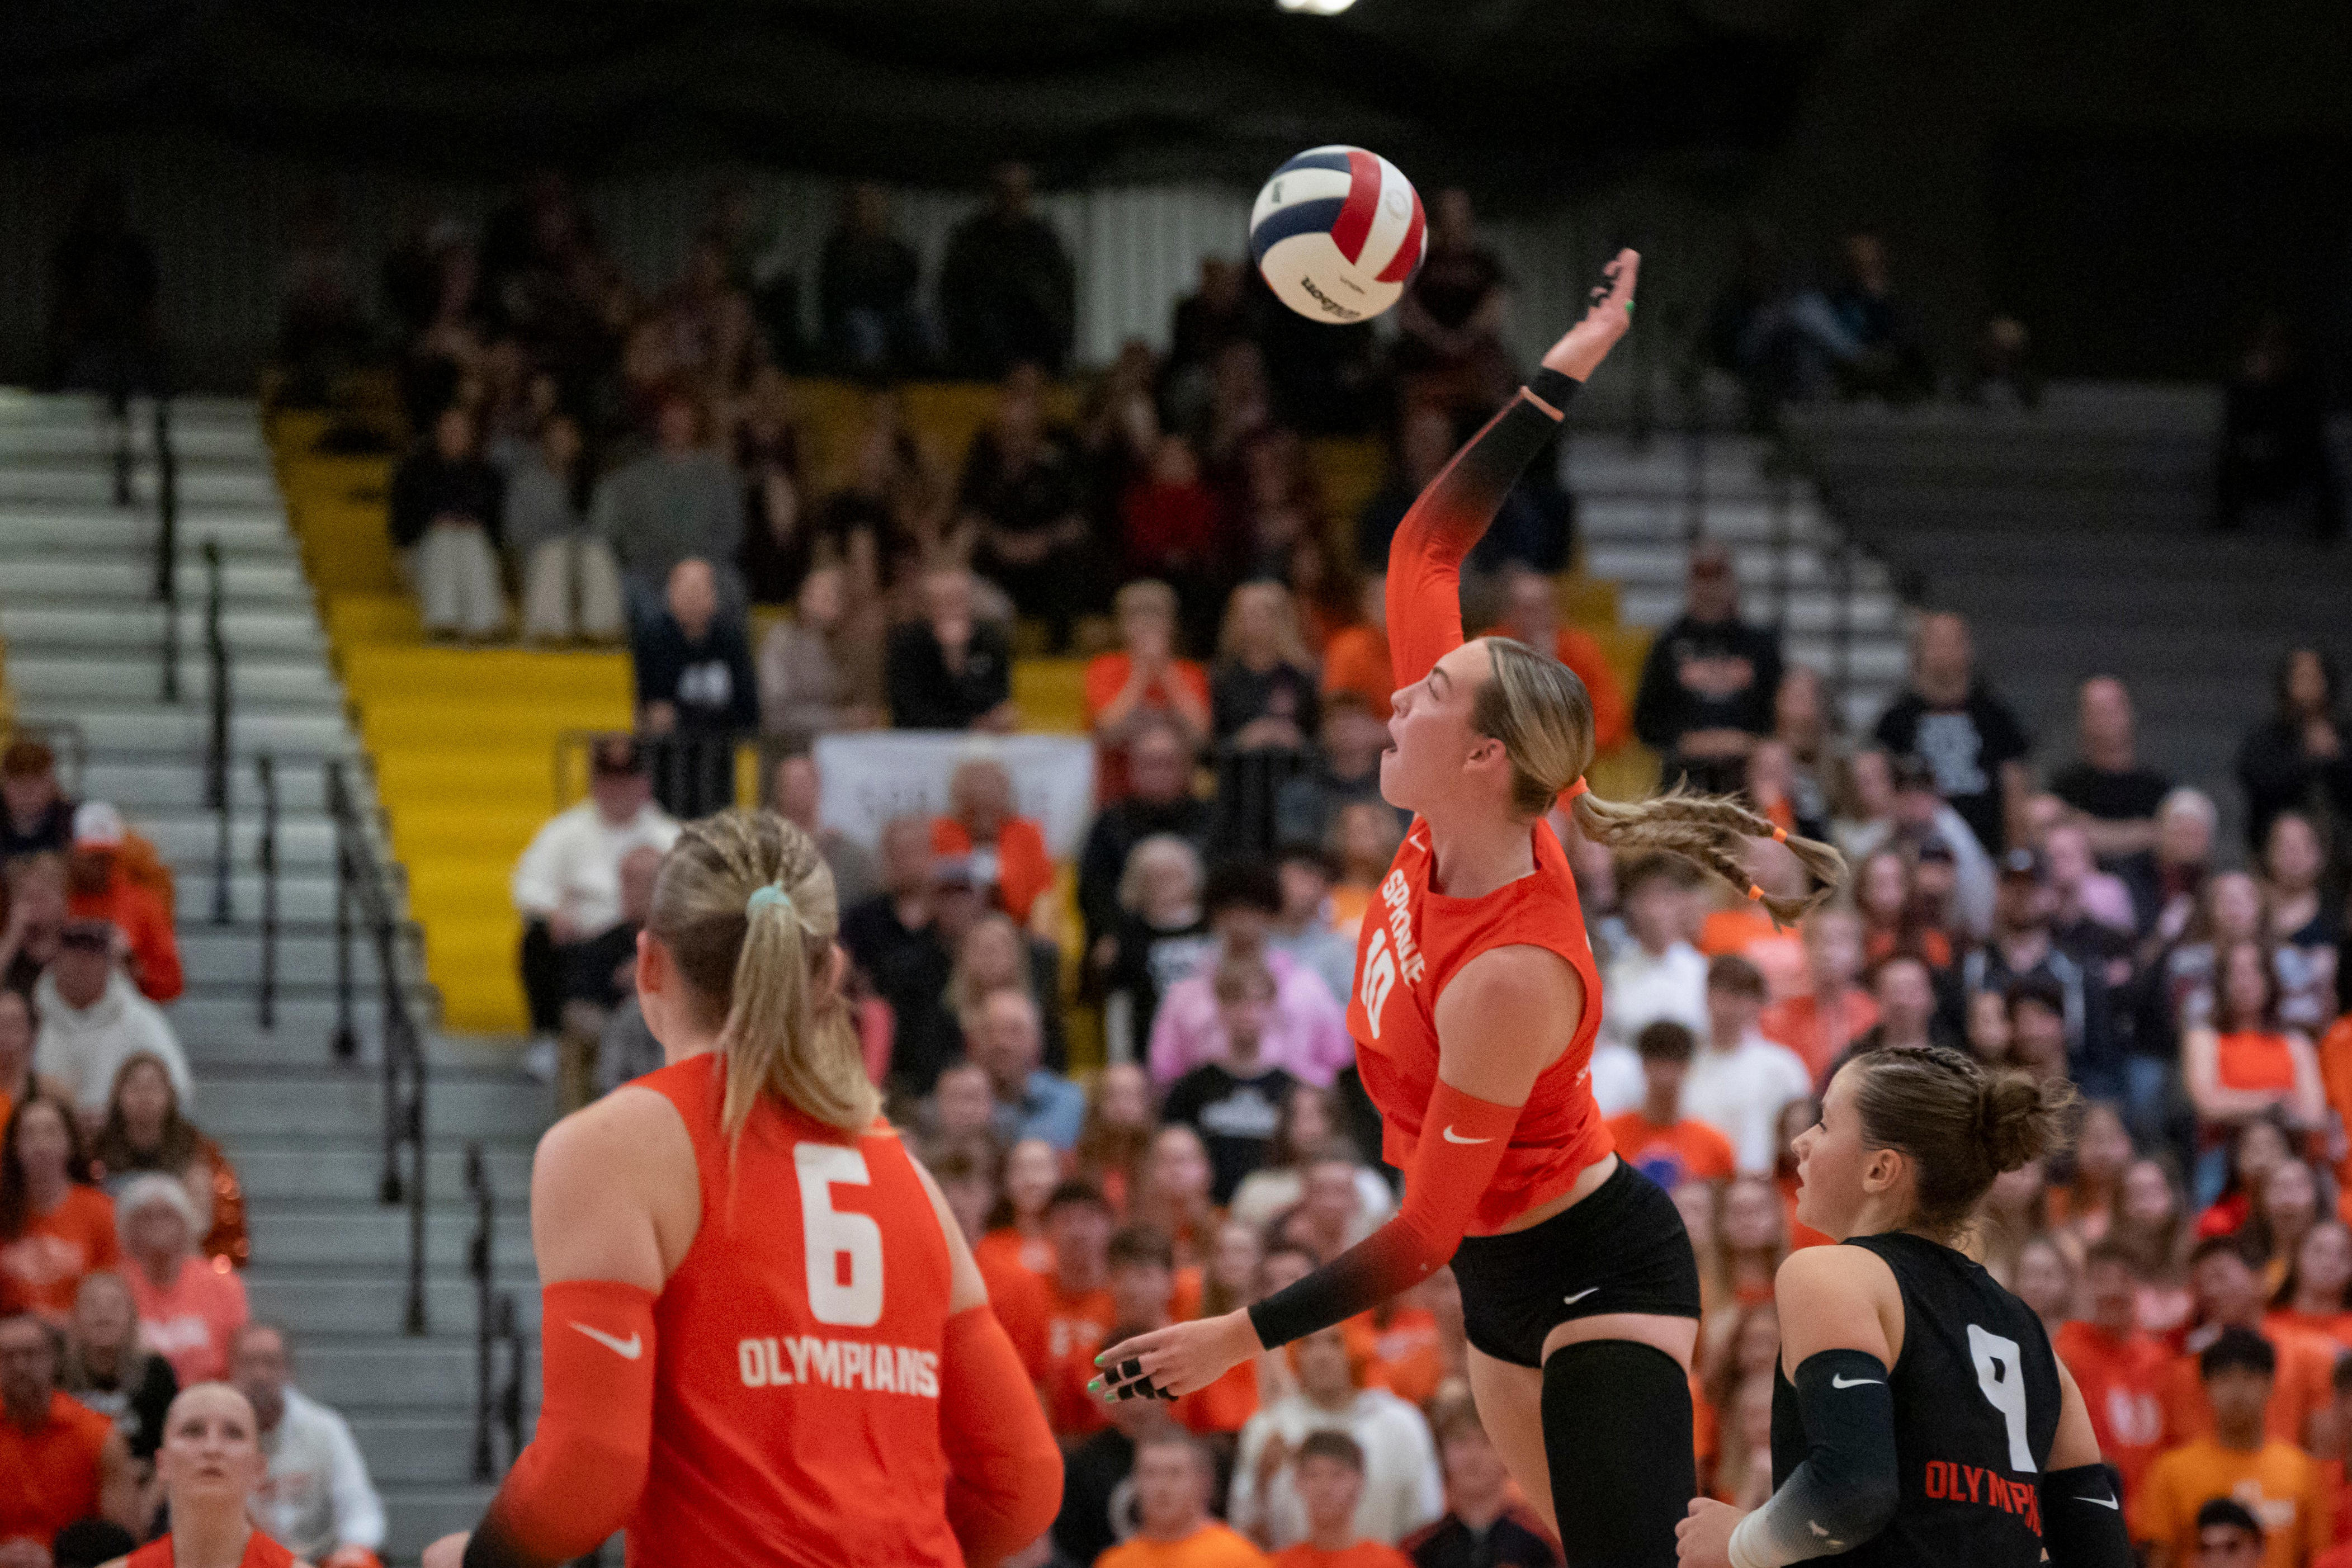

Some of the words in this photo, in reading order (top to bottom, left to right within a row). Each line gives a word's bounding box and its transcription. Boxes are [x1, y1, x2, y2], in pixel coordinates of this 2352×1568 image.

[793, 1141, 884, 1327] 6
[739, 1335, 940, 1397] OLYMPIANS
[1967, 1324, 2038, 1473] 9
